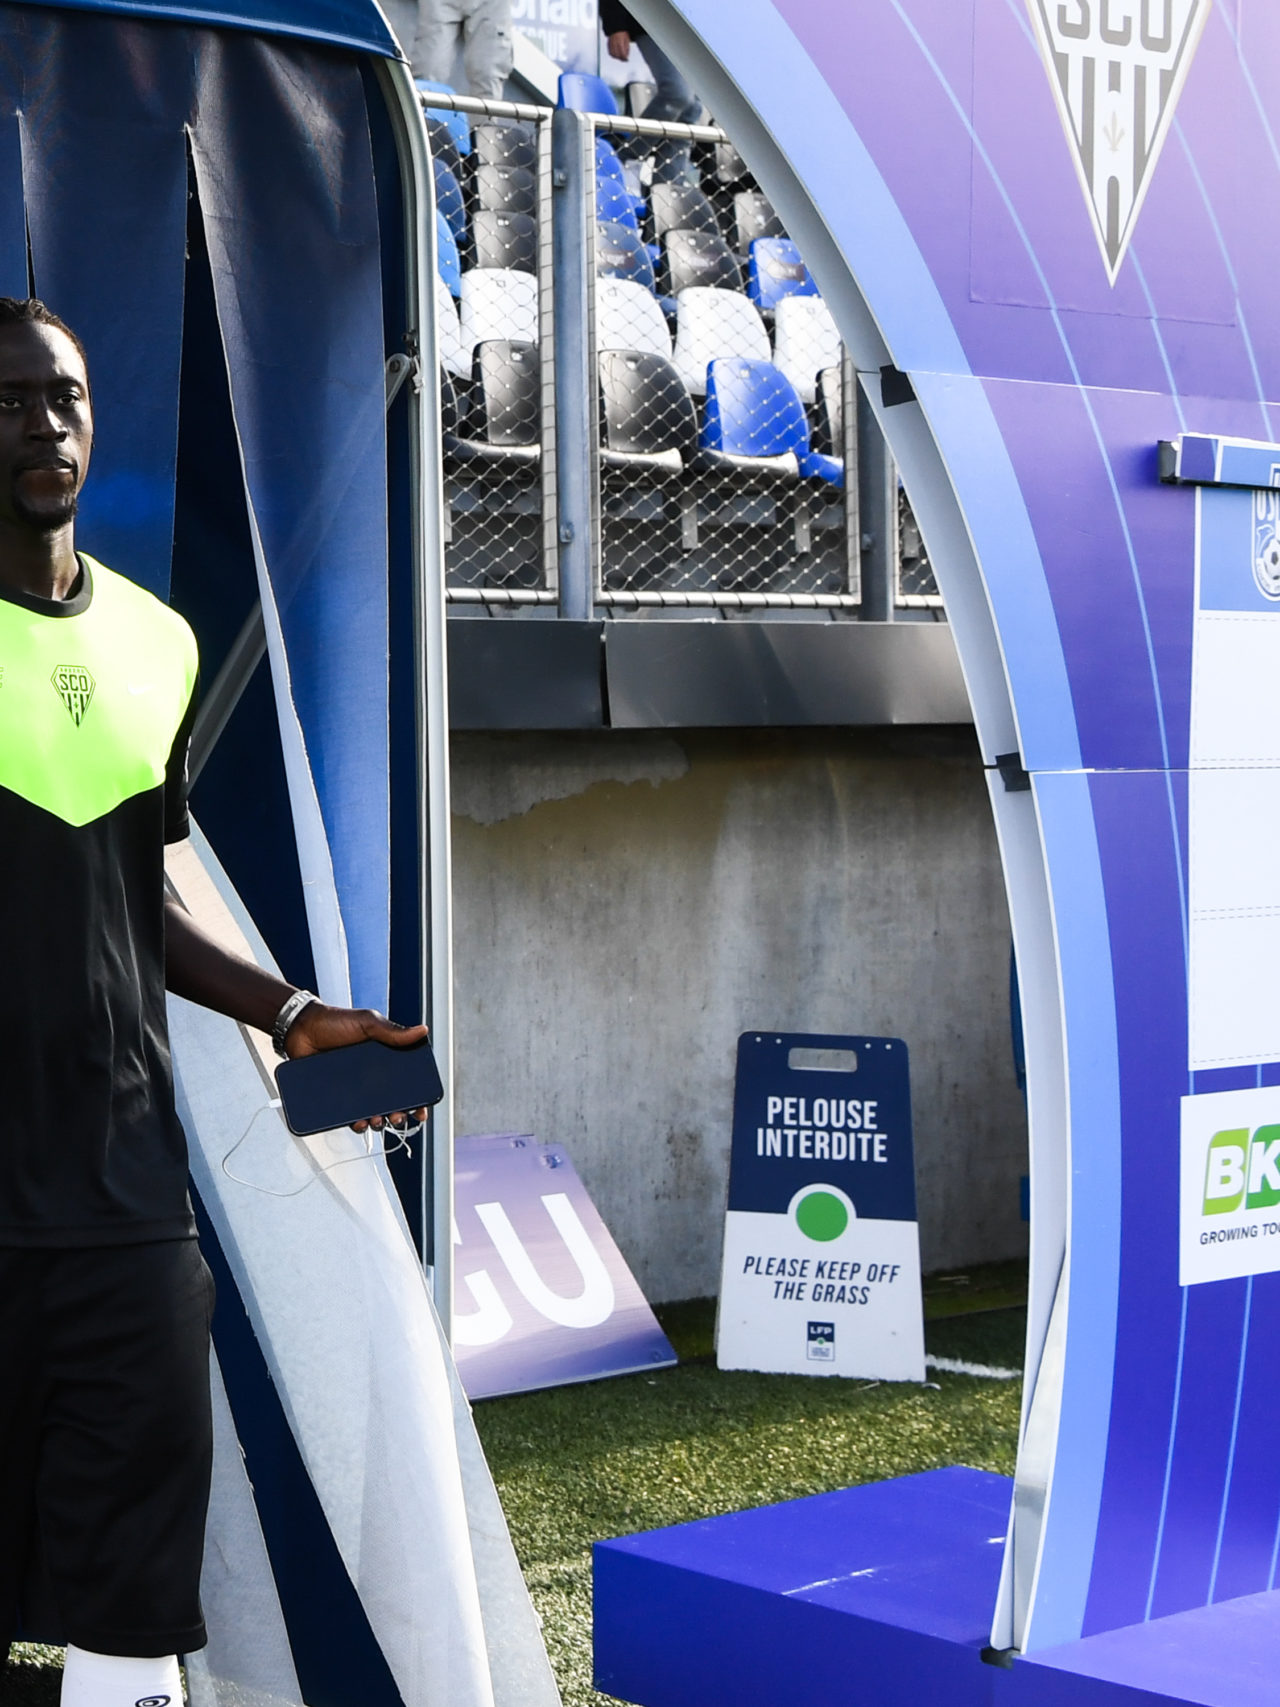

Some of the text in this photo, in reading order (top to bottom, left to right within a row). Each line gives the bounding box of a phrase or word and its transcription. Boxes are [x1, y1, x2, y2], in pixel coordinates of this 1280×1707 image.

[59, 673, 89, 692] SCO
[767, 1096, 878, 1130] PELOUSE
[757, 1128, 888, 1163] INTERDITE
[1200, 1224, 1258, 1245] GROWING
[743, 1256, 901, 1284] PLEASE KEEP OFF
[773, 1280, 871, 1306] THE GRASS
[810, 1326, 832, 1335] LFP
